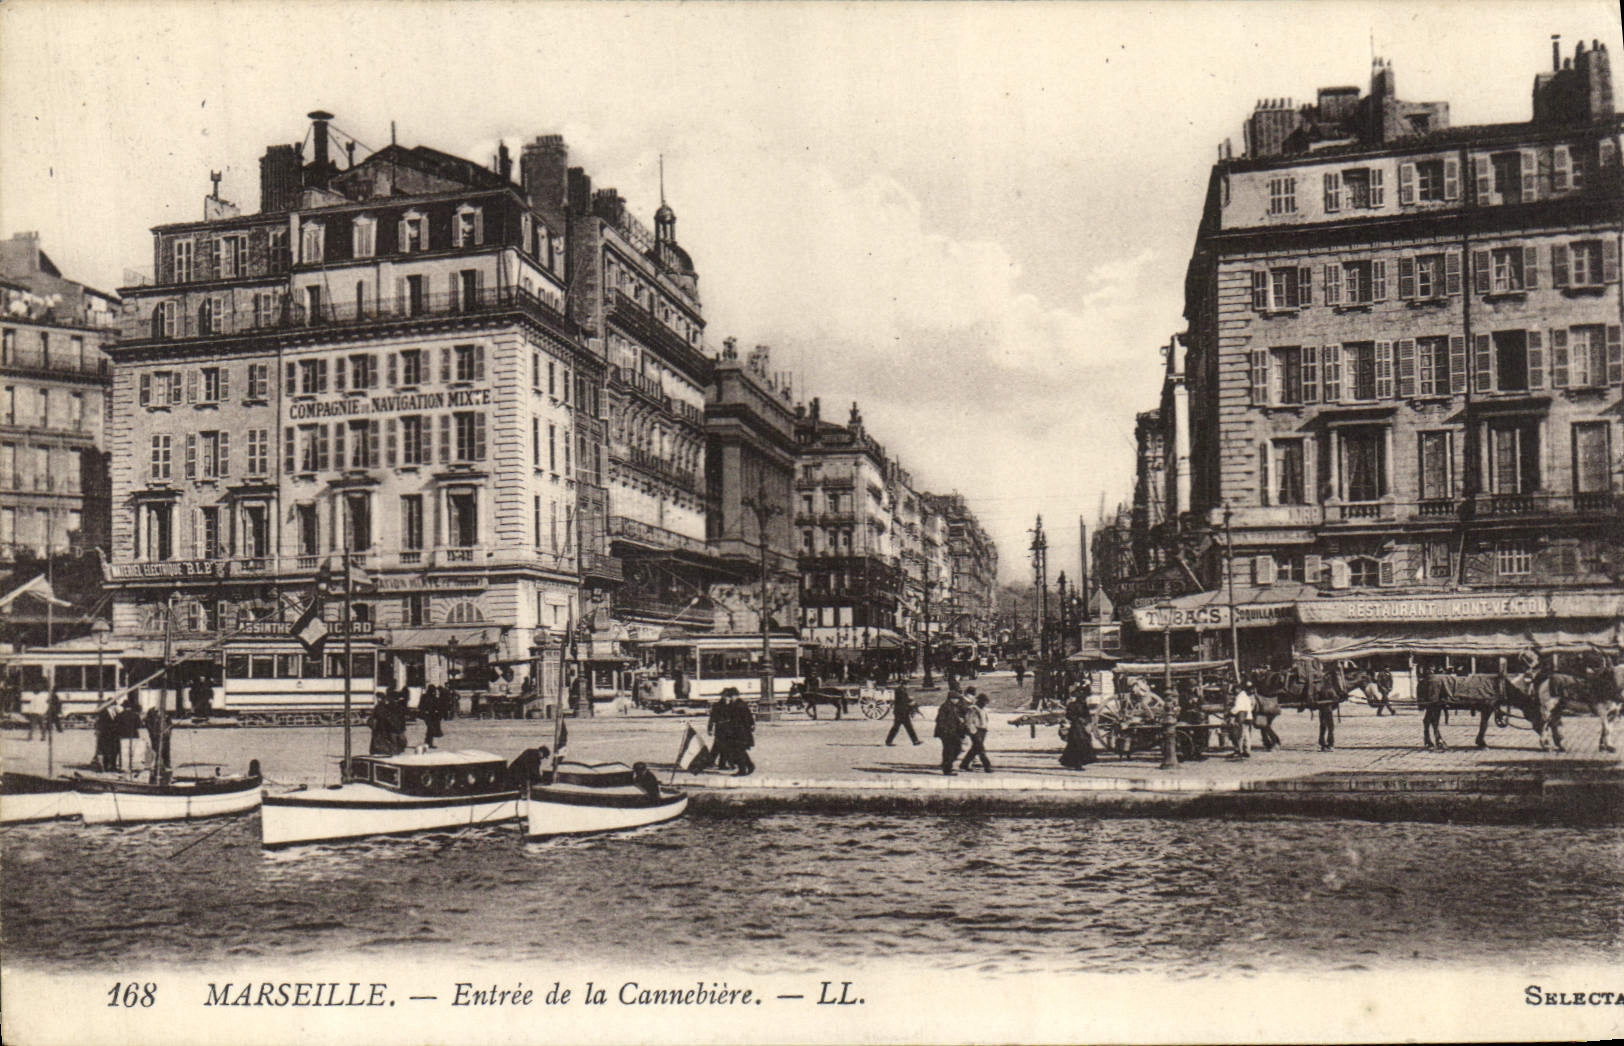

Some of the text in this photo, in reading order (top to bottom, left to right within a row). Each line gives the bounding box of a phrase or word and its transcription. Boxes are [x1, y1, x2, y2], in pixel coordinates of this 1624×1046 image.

[289, 400, 359, 420] COMPAGNIE
[371, 393, 444, 412] NAVIGATION
[1146, 608, 1222, 626] TBACS
[1347, 602, 1435, 619] RESTAURANT
[1451, 599, 1553, 617] MONT-VENTOU
[325, 621, 372, 634] ICRD
